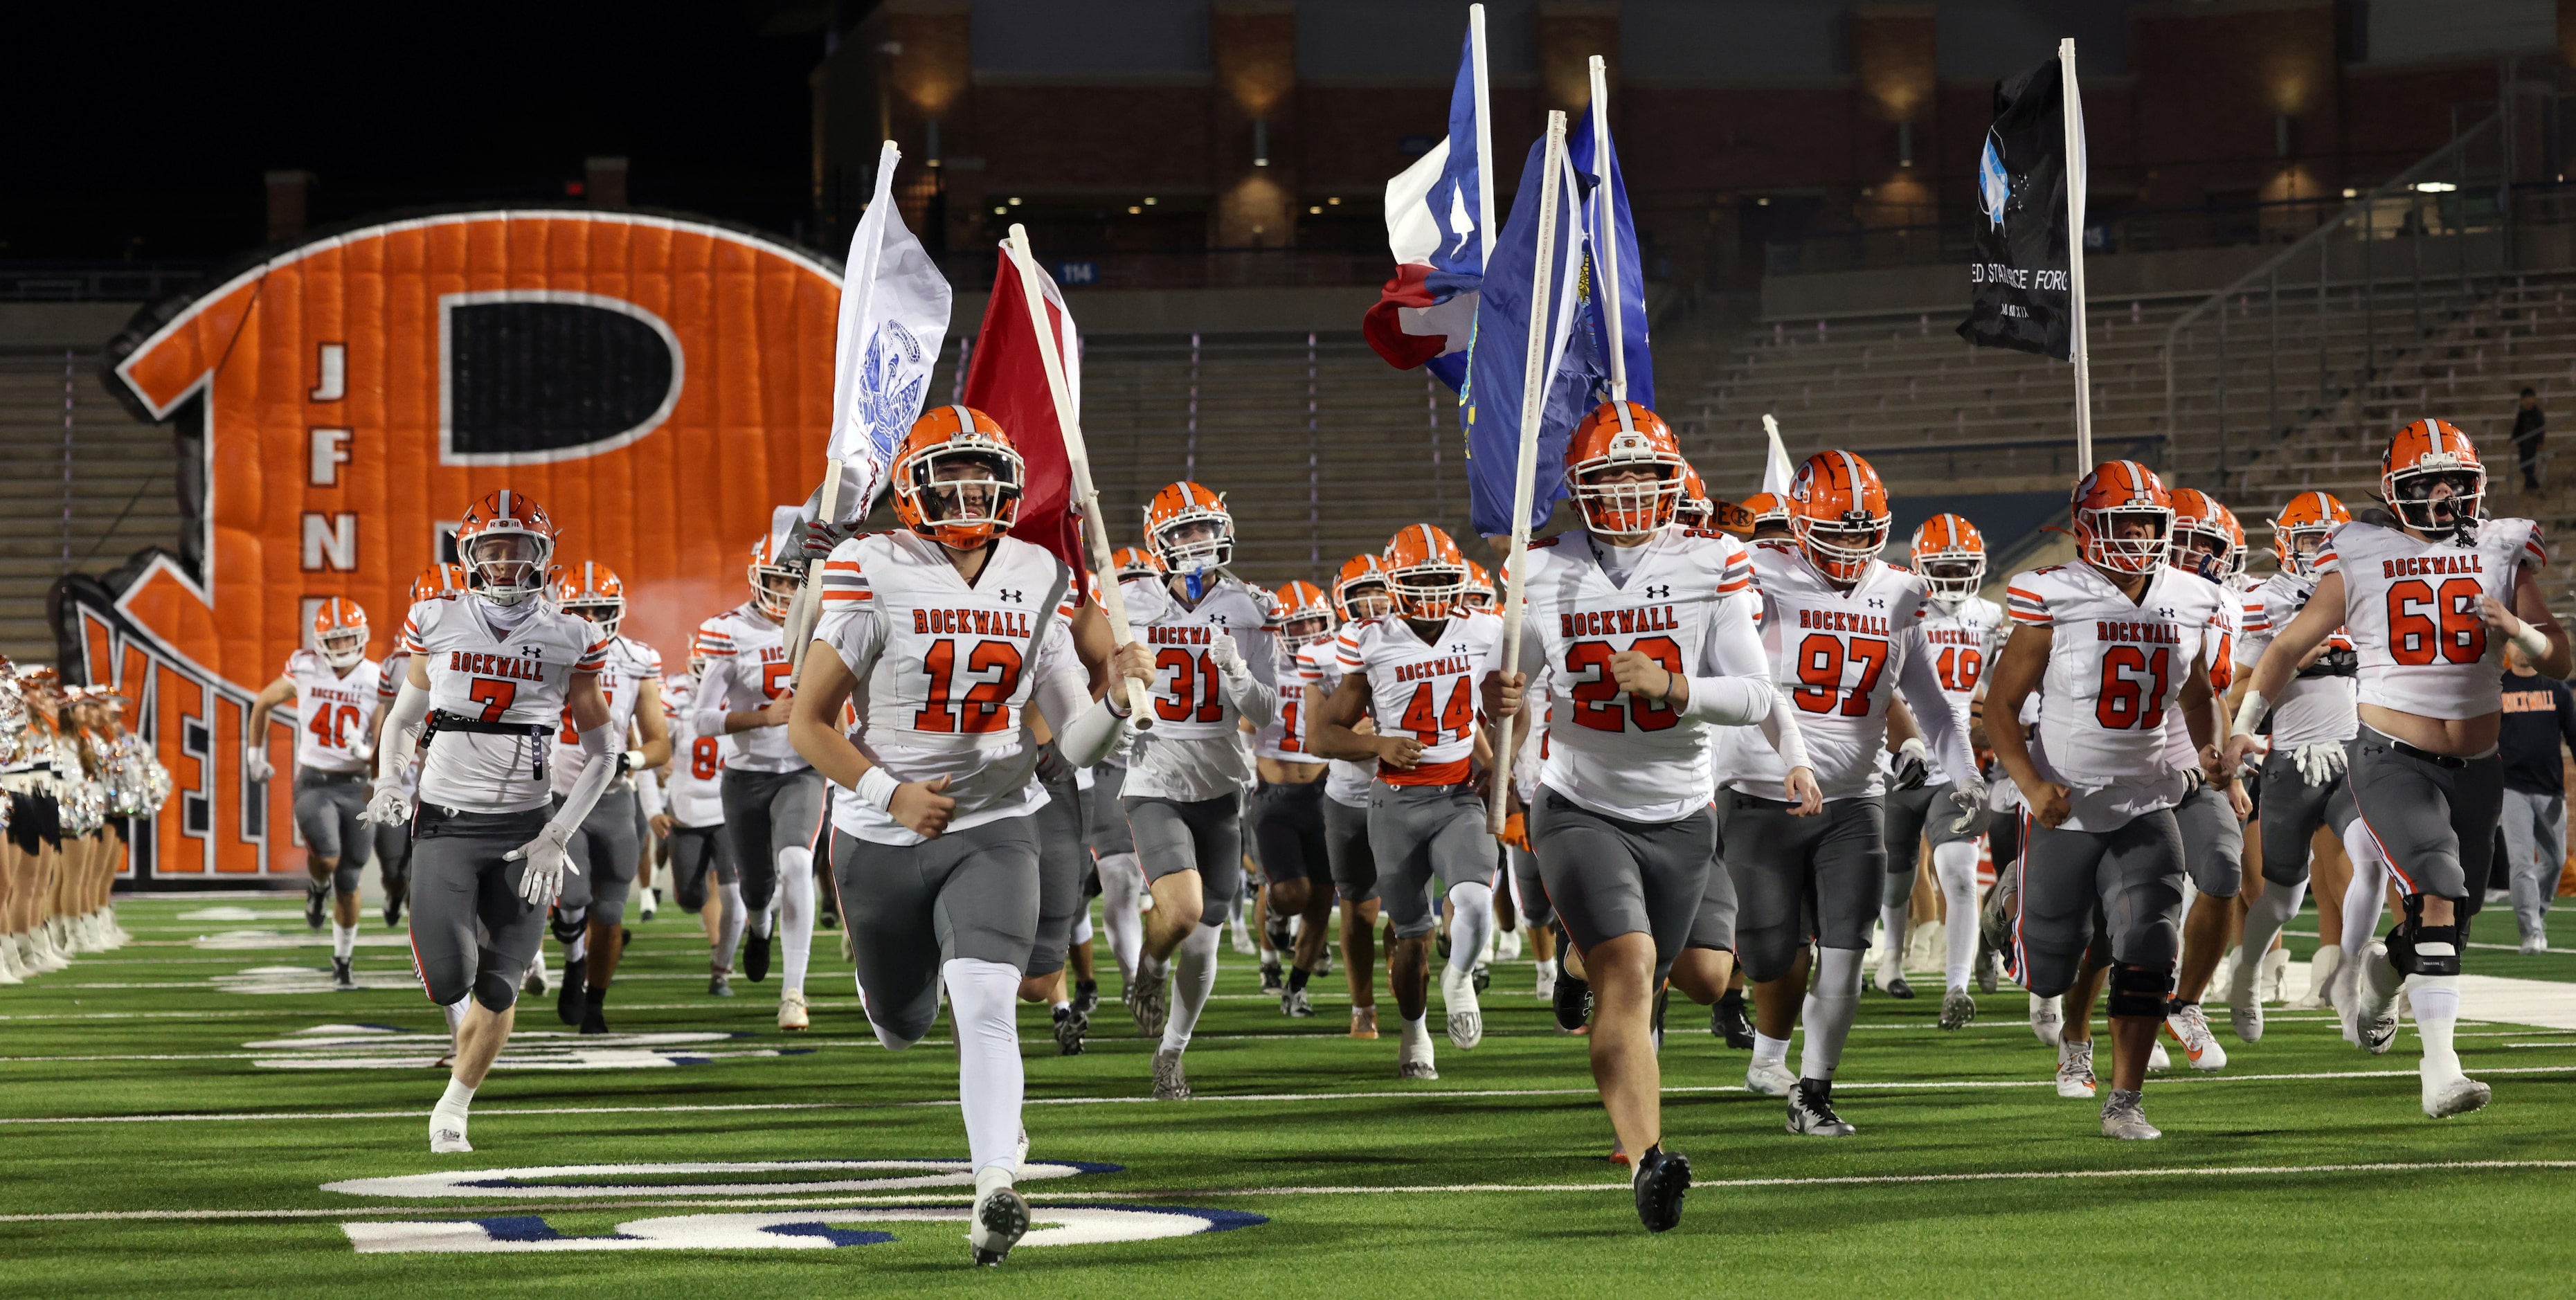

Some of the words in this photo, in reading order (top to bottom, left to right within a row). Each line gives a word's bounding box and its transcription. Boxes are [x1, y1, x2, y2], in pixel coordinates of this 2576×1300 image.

[1063, 263, 1092, 282] 114
[2383, 554, 2483, 579] ROCKWALL
[913, 609, 1030, 638] ROCKWALL
[1561, 606, 1678, 638] ROCKWALL
[1800, 610, 1889, 636] ROCKWALL
[2097, 622, 2180, 644] ROCKWALL
[1927, 630, 1981, 647] ROCKWALL
[450, 651, 543, 682] ROCKWALL
[1396, 654, 1471, 682] ROCKWALL
[1793, 633, 1889, 717] 97
[469, 677, 517, 723] 7
[914, 638, 1023, 734] 12
[1155, 647, 1223, 723] 31
[2095, 645, 2169, 730] 61
[1400, 676, 1473, 747] 44
